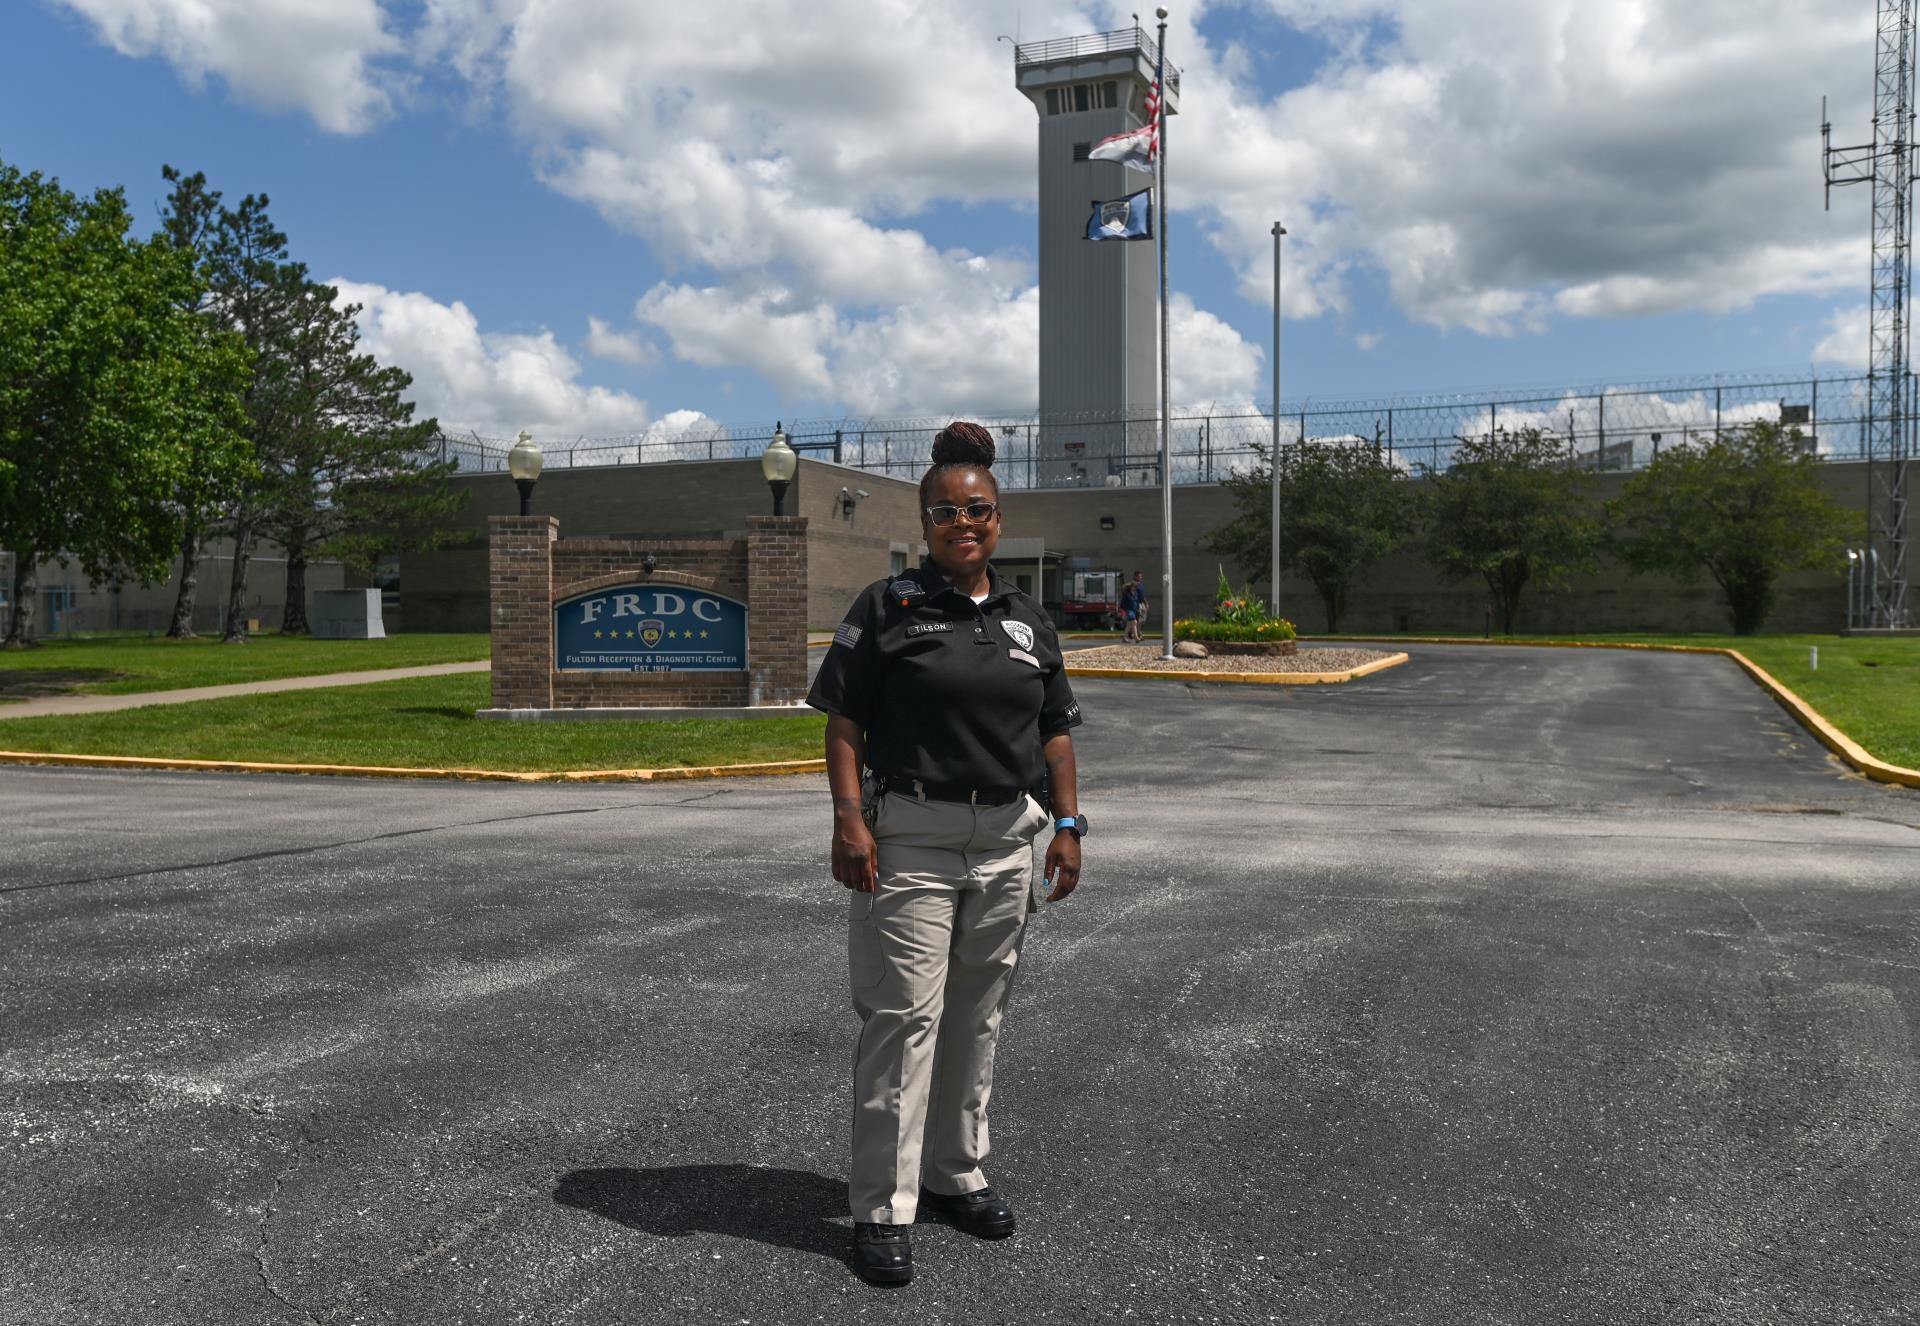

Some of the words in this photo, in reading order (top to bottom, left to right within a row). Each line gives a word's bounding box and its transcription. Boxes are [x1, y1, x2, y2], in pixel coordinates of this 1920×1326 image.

[580, 593, 723, 624] FRDC
[914, 623, 946, 633] TILSON
[566, 655, 596, 663] FULTON
[599, 655, 643, 663] RECEPTION
[645, 655, 652, 663] &
[655, 655, 704, 663] DIAGNOSTIC
[706, 655, 737, 663] CENTER
